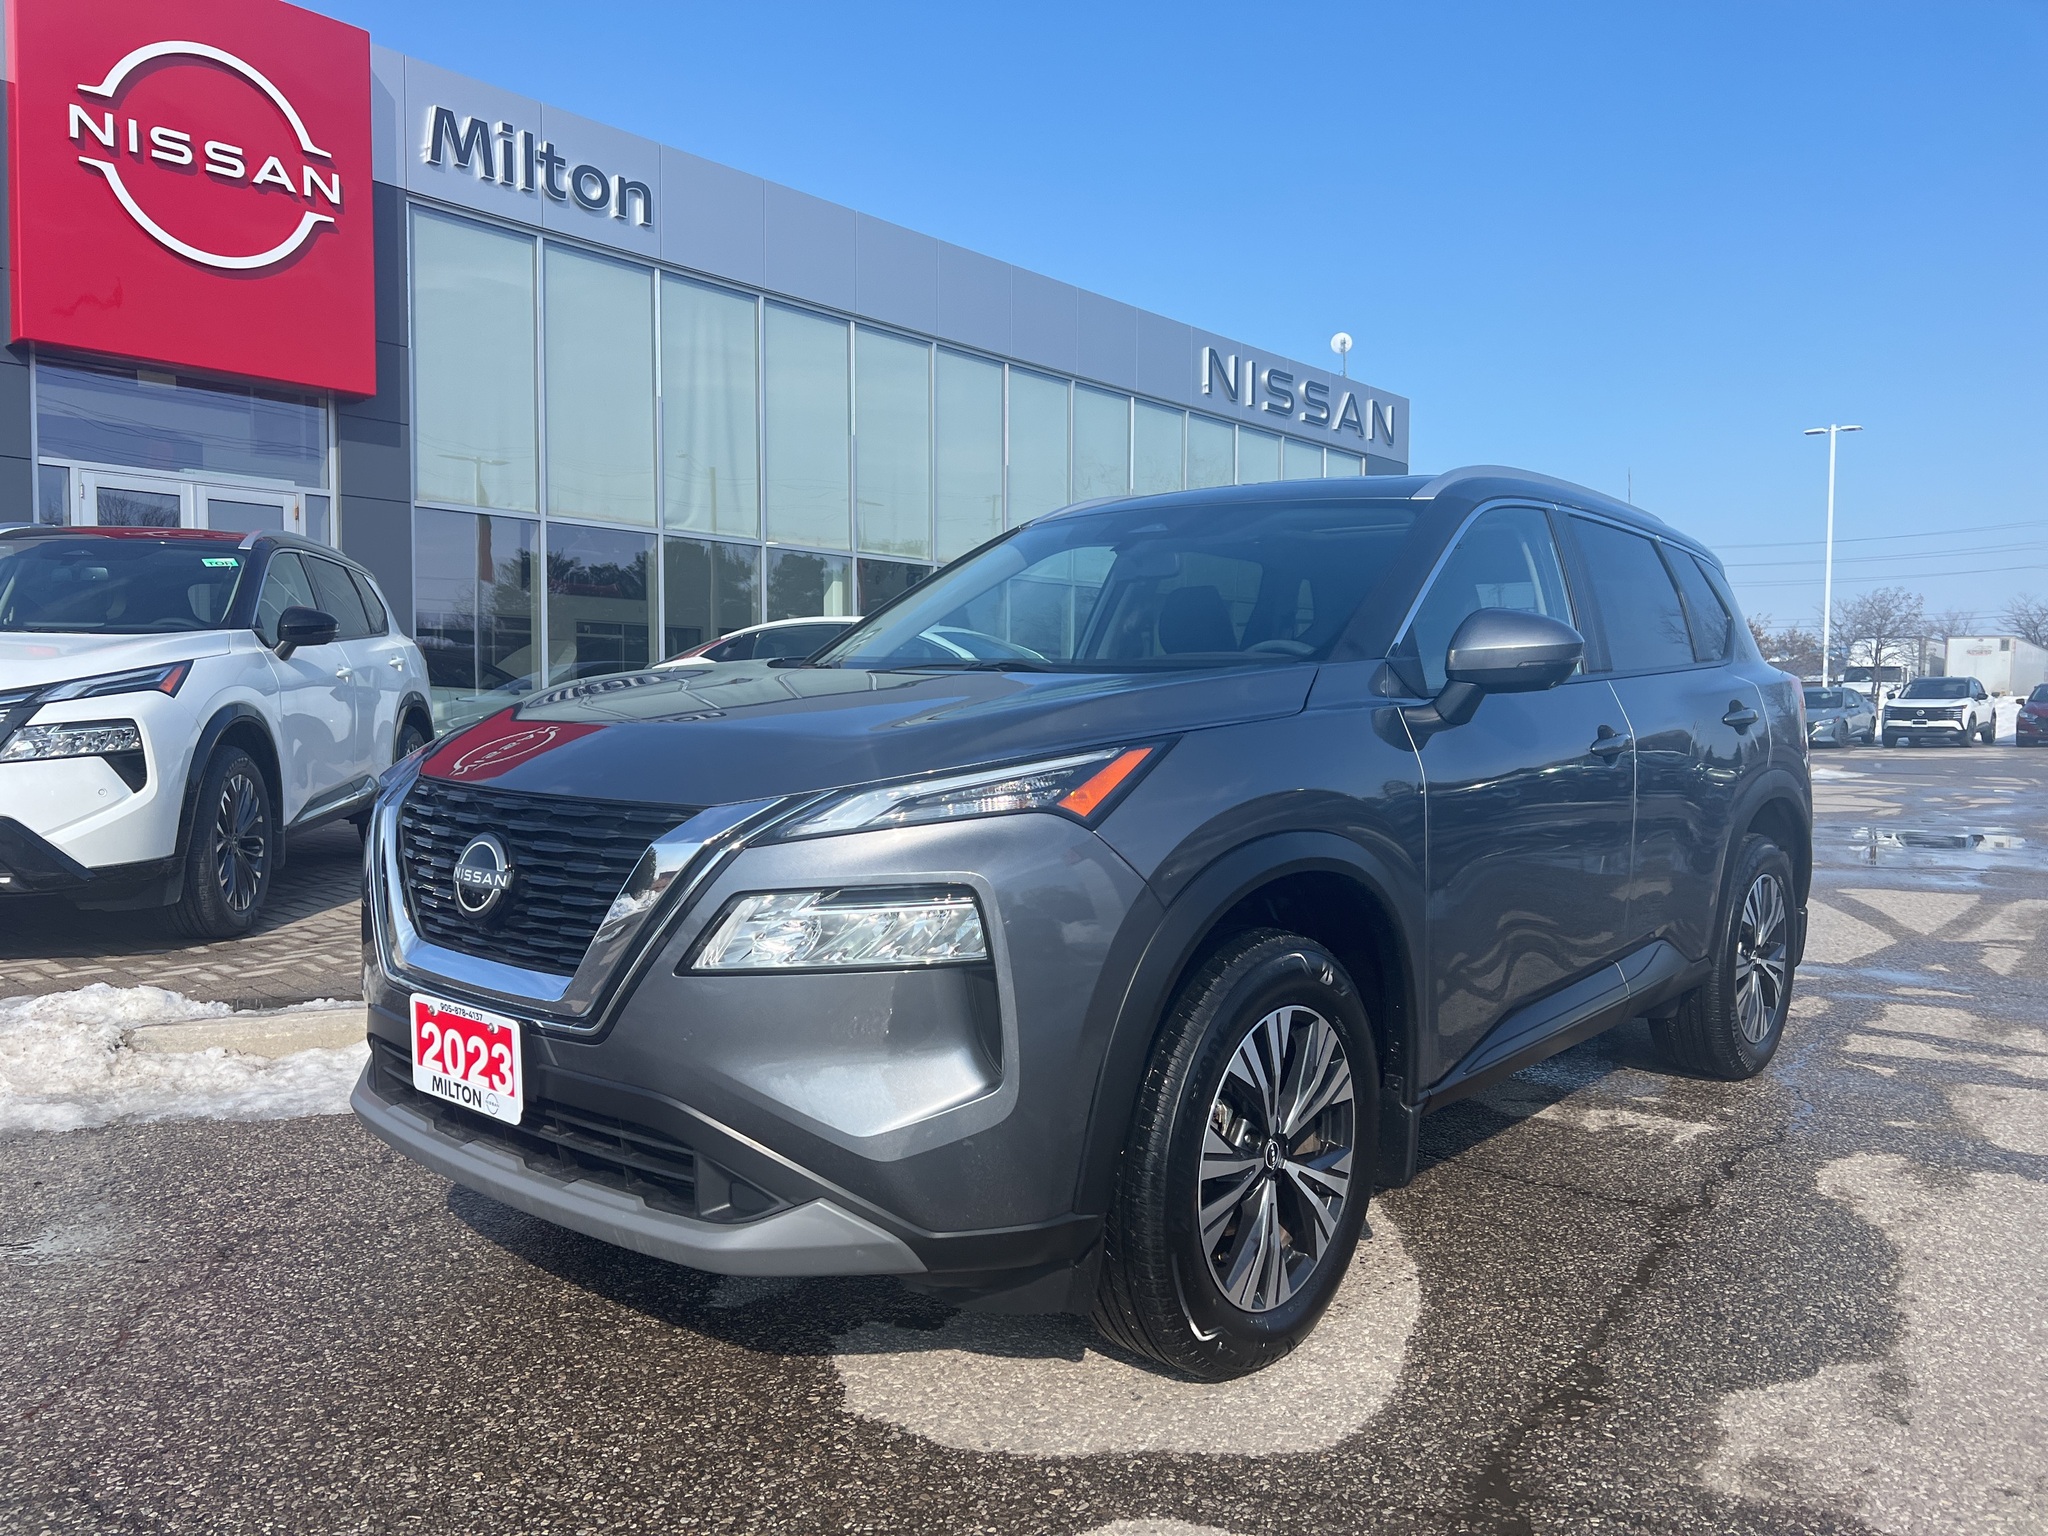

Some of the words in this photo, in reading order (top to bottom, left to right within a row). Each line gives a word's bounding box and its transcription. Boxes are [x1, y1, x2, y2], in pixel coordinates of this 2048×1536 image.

[68, 103, 341, 205] NISSAN
[426, 104, 653, 225] Milton
[1202, 346, 1395, 445] NISSAN
[454, 866, 507, 887] NISSAN
[439, 1002, 483, 1022] 905-878-4137
[420, 1021, 514, 1096] 2023
[432, 1074, 482, 1108] MILTON
